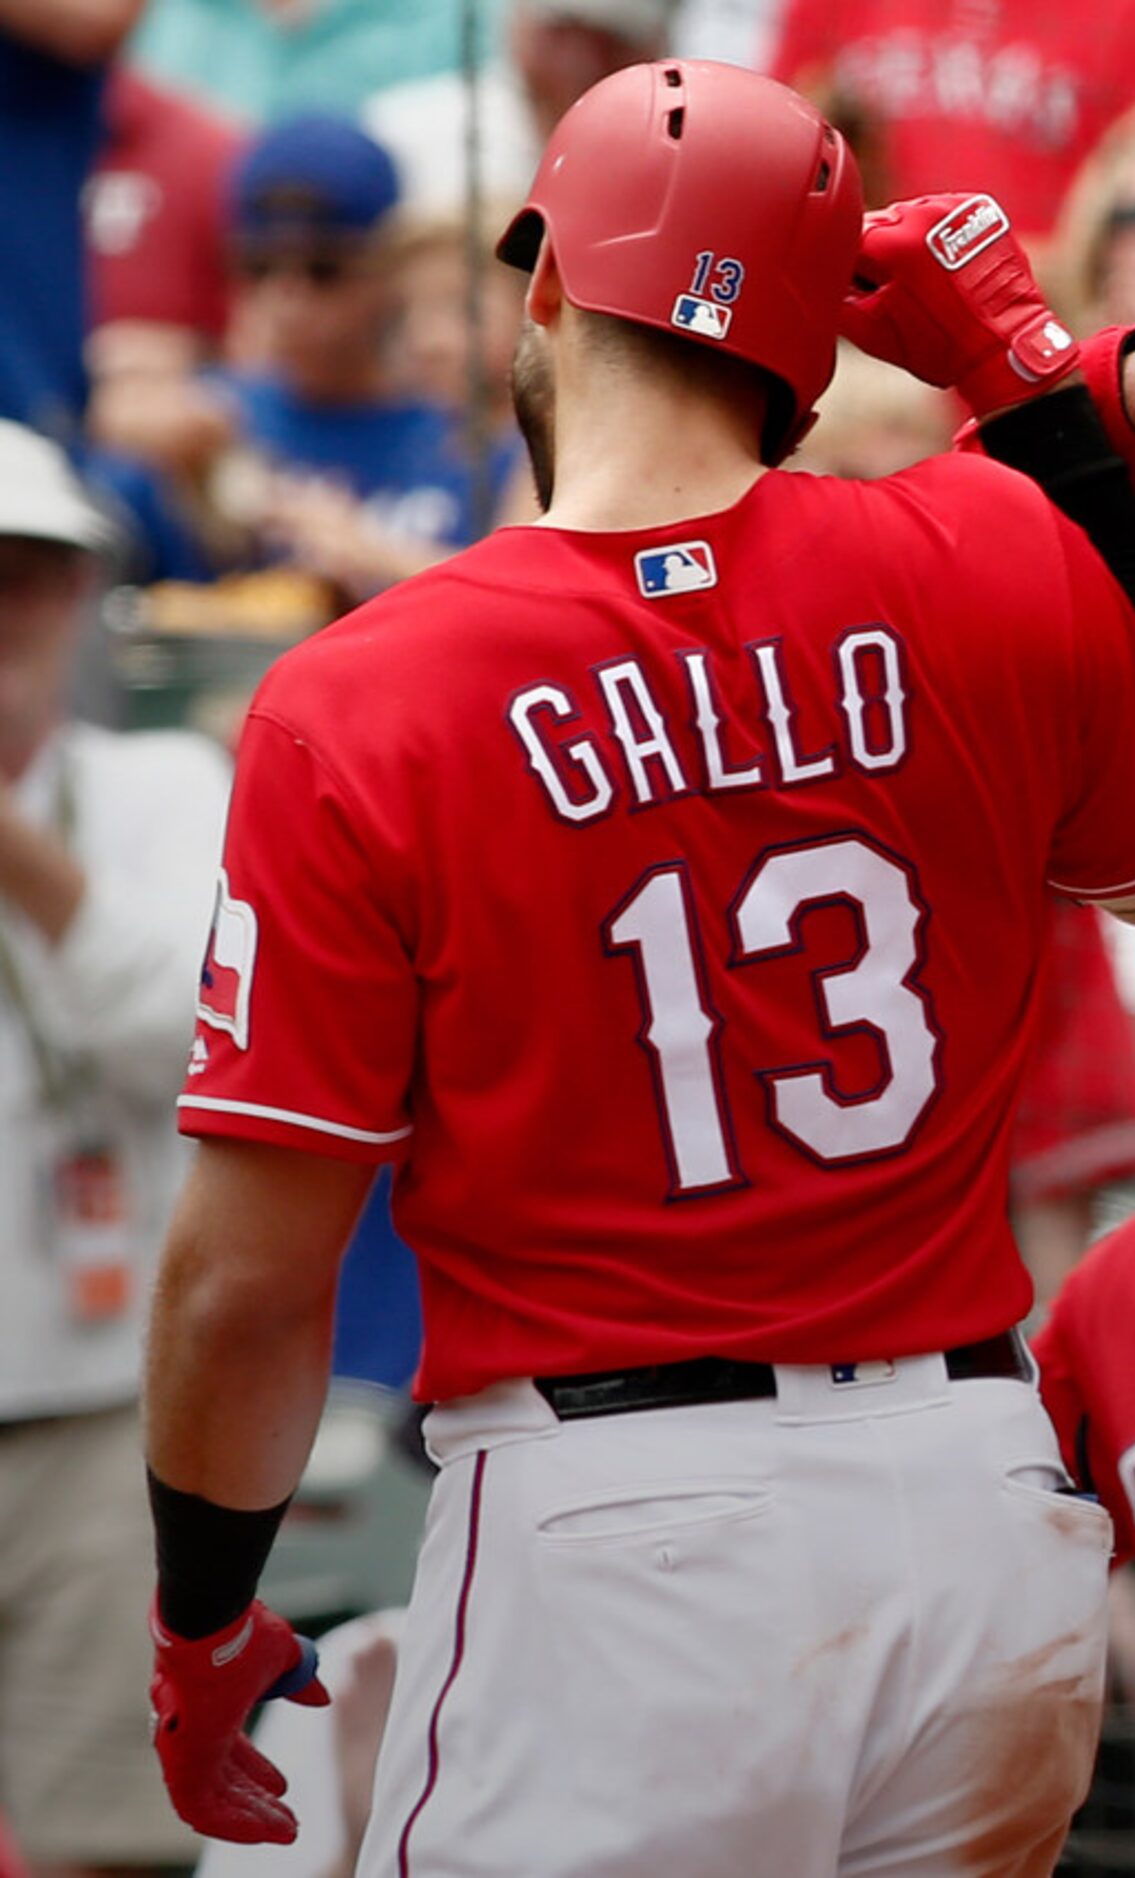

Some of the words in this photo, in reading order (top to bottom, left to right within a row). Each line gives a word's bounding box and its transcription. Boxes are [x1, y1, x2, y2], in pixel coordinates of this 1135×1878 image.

[689, 249, 746, 305] 13
[505, 622, 906, 829] GALLO
[600, 826, 947, 1207] 13
